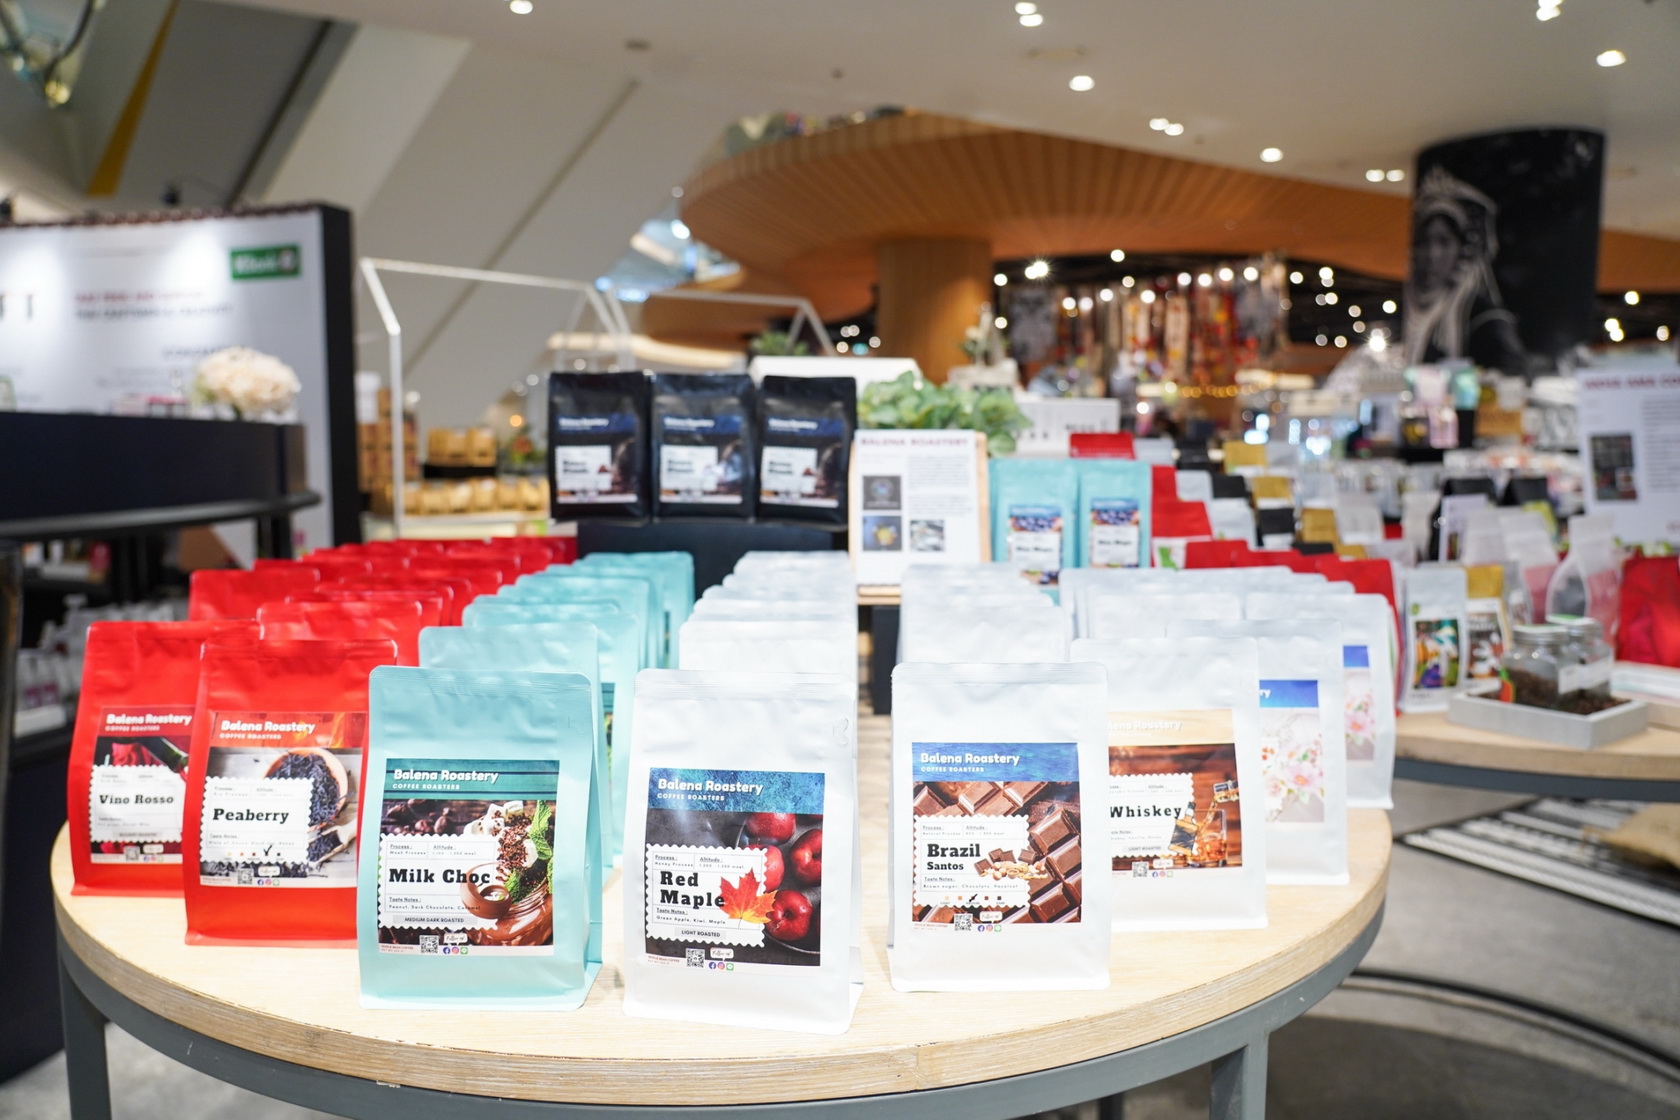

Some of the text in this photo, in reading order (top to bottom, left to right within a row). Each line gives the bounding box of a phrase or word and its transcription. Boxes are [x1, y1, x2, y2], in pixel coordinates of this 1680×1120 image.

[106, 714, 192, 726] Balena Roastery
[1108, 720, 1182, 731] lena Roastery
[221, 721, 315, 734] Balena Roastery
[921, 753, 1020, 766] Balena Roastery
[394, 769, 499, 784] Balena Roastery
[658, 778, 763, 796] Balena Roastery
[100, 794, 174, 804] Vino Rosso
[212, 808, 289, 824] Peaberry
[1110, 805, 1182, 820] Whiskey
[927, 844, 980, 857] Brazil
[927, 862, 964, 870] Santos
[389, 868, 491, 884] Milk Choc
[660, 871, 698, 886] Red
[660, 890, 725, 909] Maple
